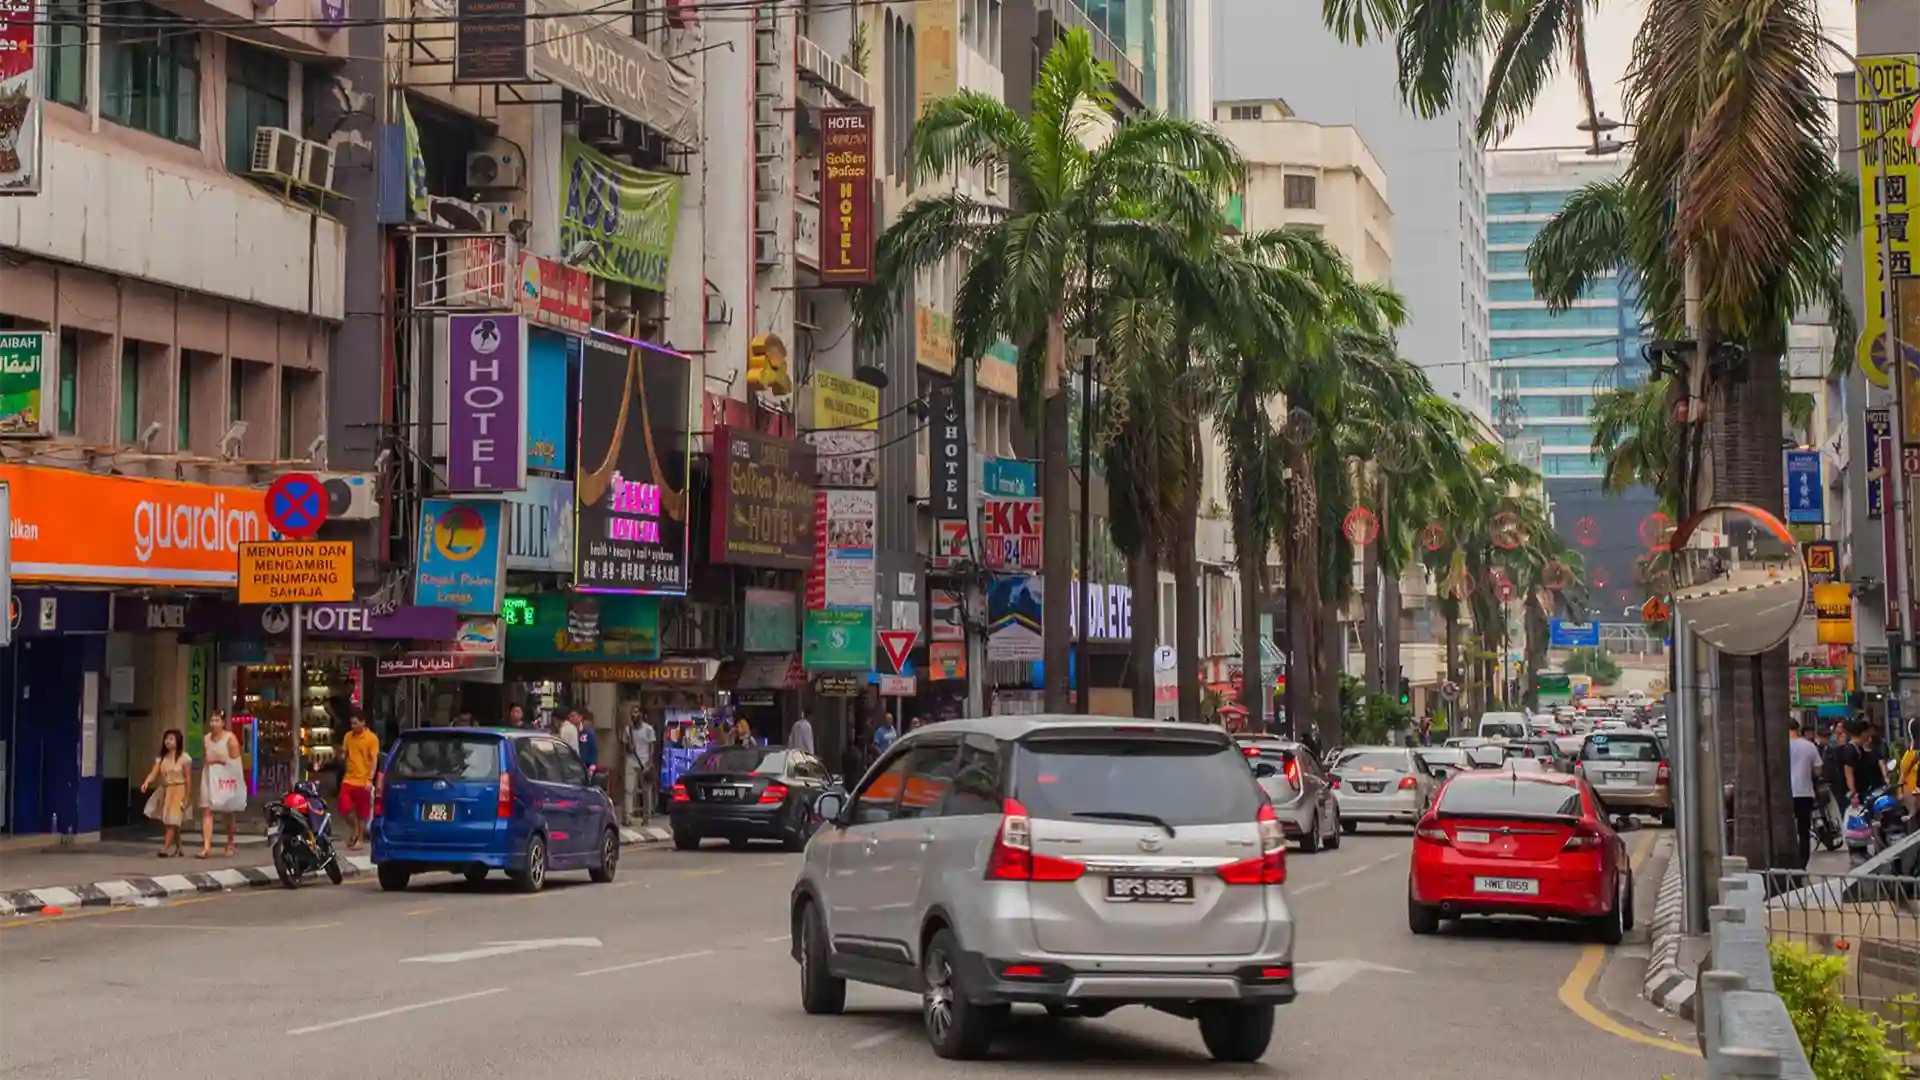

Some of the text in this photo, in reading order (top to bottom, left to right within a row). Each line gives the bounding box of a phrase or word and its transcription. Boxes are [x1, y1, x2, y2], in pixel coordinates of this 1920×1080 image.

[1862, 63, 1912, 95] HOTEL
[828, 116, 865, 128] HOTEL
[840, 183, 852, 264] HOTEL
[464, 359, 504, 488] HOTEL
[945, 426, 958, 510] HOTEL
[134, 491, 259, 562] guardian
[748, 504, 796, 545] HOTEL
[247, 545, 346, 557] MENURUN DAN
[1005, 540, 1020, 564] 24
[254, 559, 336, 571] MENGAMBIL
[253, 572, 338, 584] PENUMPANG
[269, 587, 323, 598] SAHAJA
[147, 604, 186, 628] HOTEL
[299, 607, 373, 632] HOTEL
[1108, 584, 1132, 639] EYE
[1161, 650, 1170, 661] P
[649, 666, 697, 679] HOTEL
[1113, 878, 1145, 895] BPS
[1484, 879, 1505, 890] HWE
